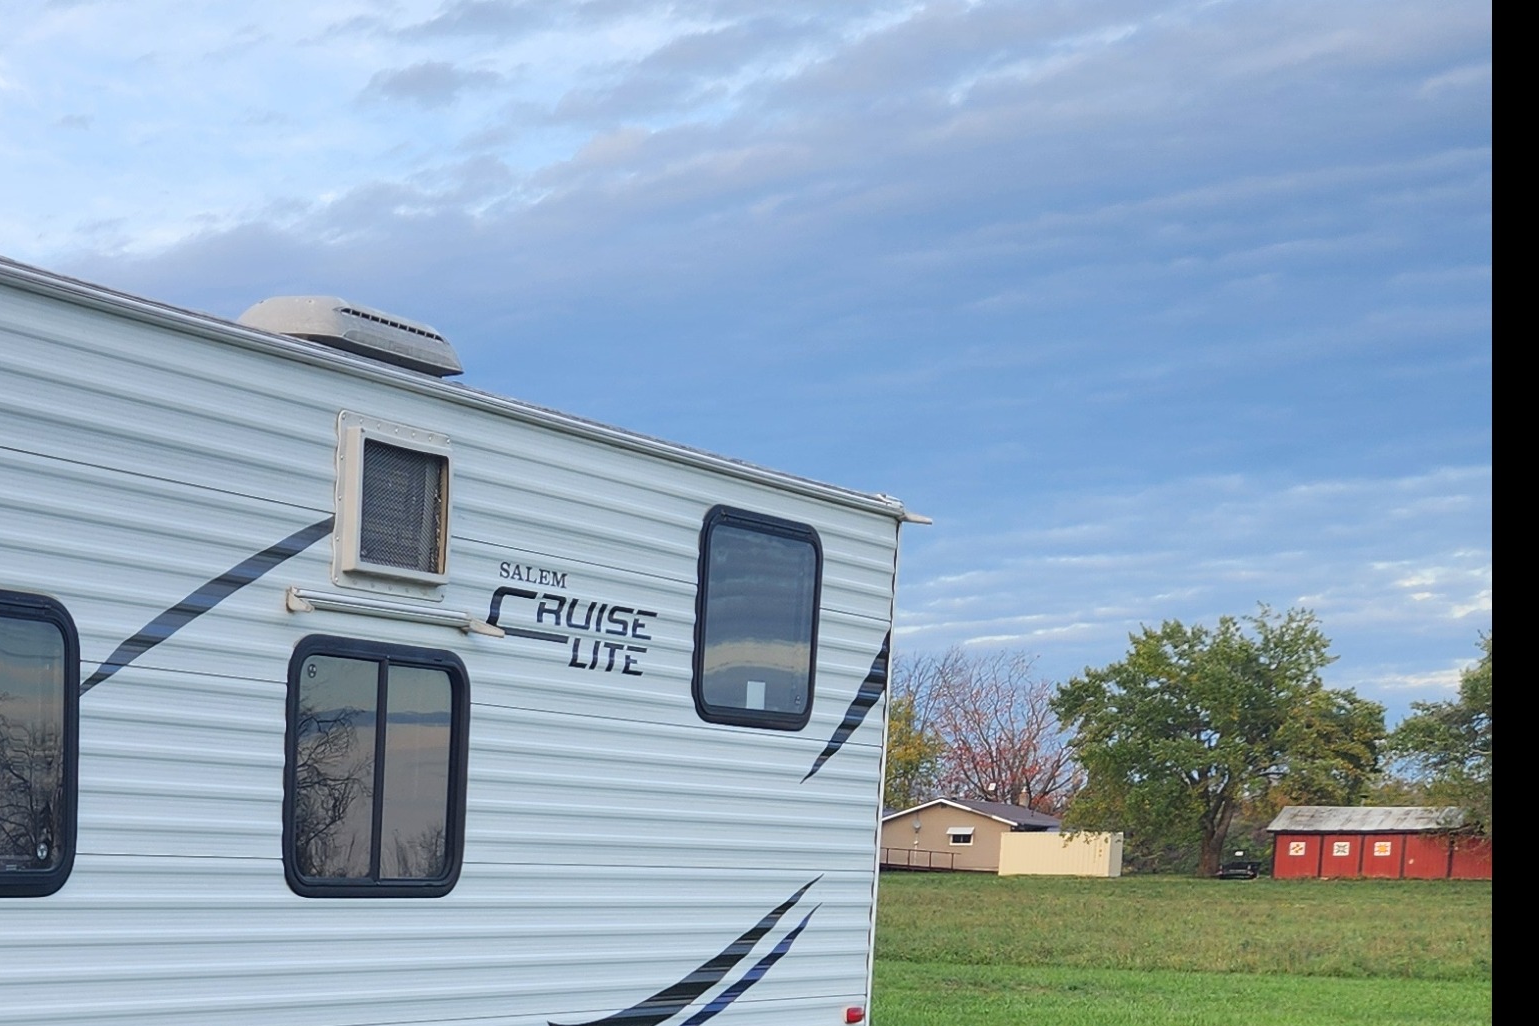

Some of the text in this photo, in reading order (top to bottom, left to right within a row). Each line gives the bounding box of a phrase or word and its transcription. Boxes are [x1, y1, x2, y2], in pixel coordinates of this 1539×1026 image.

[499, 561, 568, 589] SALEM
[486, 585, 658, 645] CRUISE
[568, 637, 648, 676] LITE
